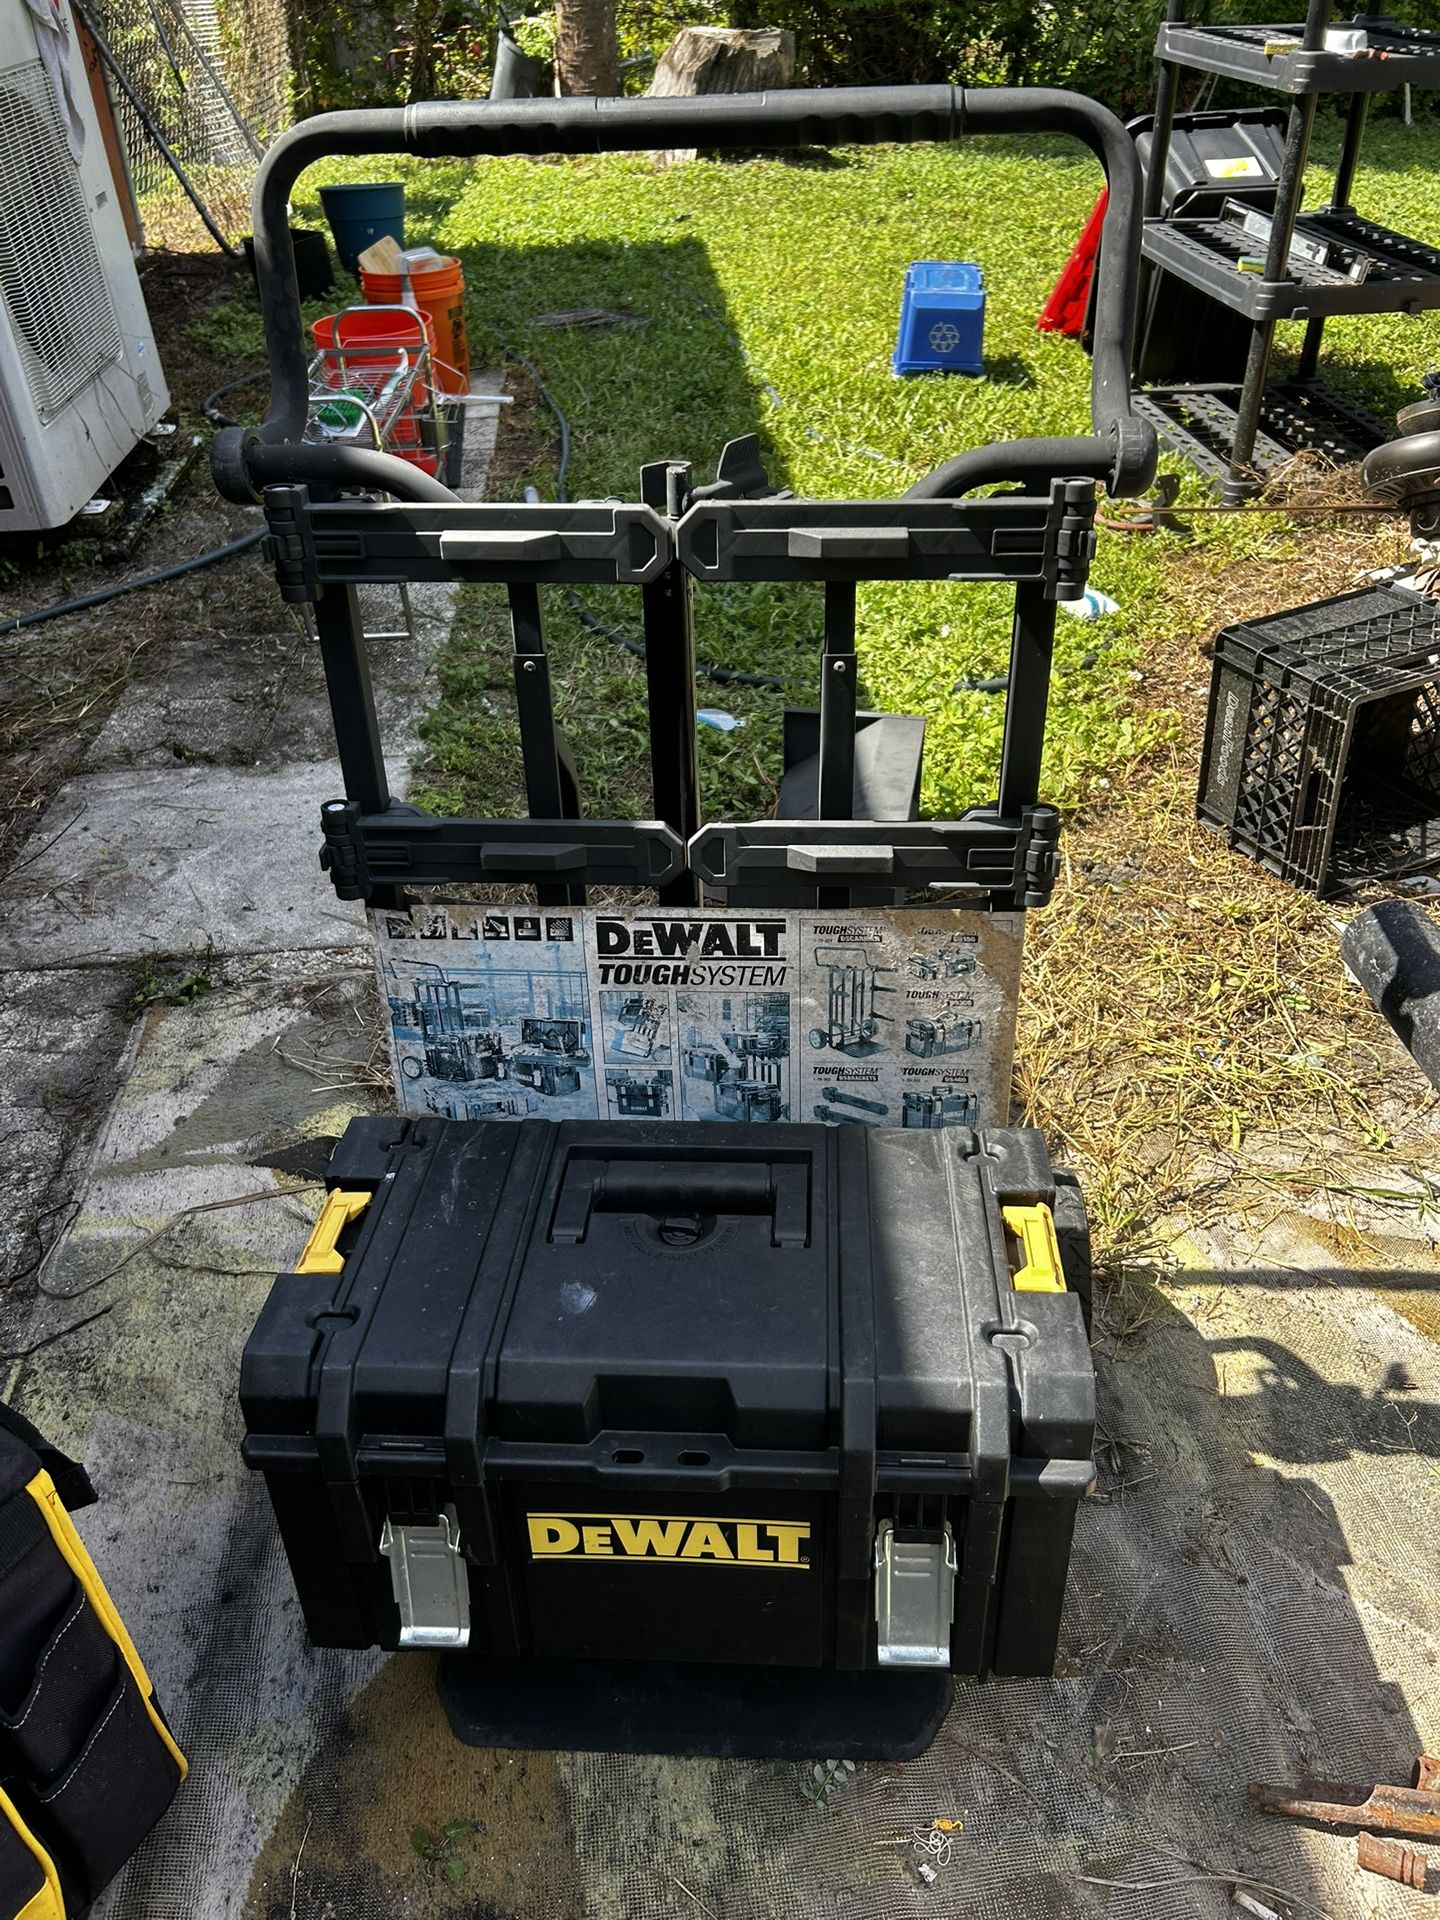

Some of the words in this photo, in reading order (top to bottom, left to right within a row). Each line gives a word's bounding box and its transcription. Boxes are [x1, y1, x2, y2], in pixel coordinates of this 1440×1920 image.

[813, 1066, 879, 1075] TOUGHSYSTEM
[903, 1067, 969, 1076] TOUGHSYSTEM
[527, 1517, 811, 1563] DEWALT
